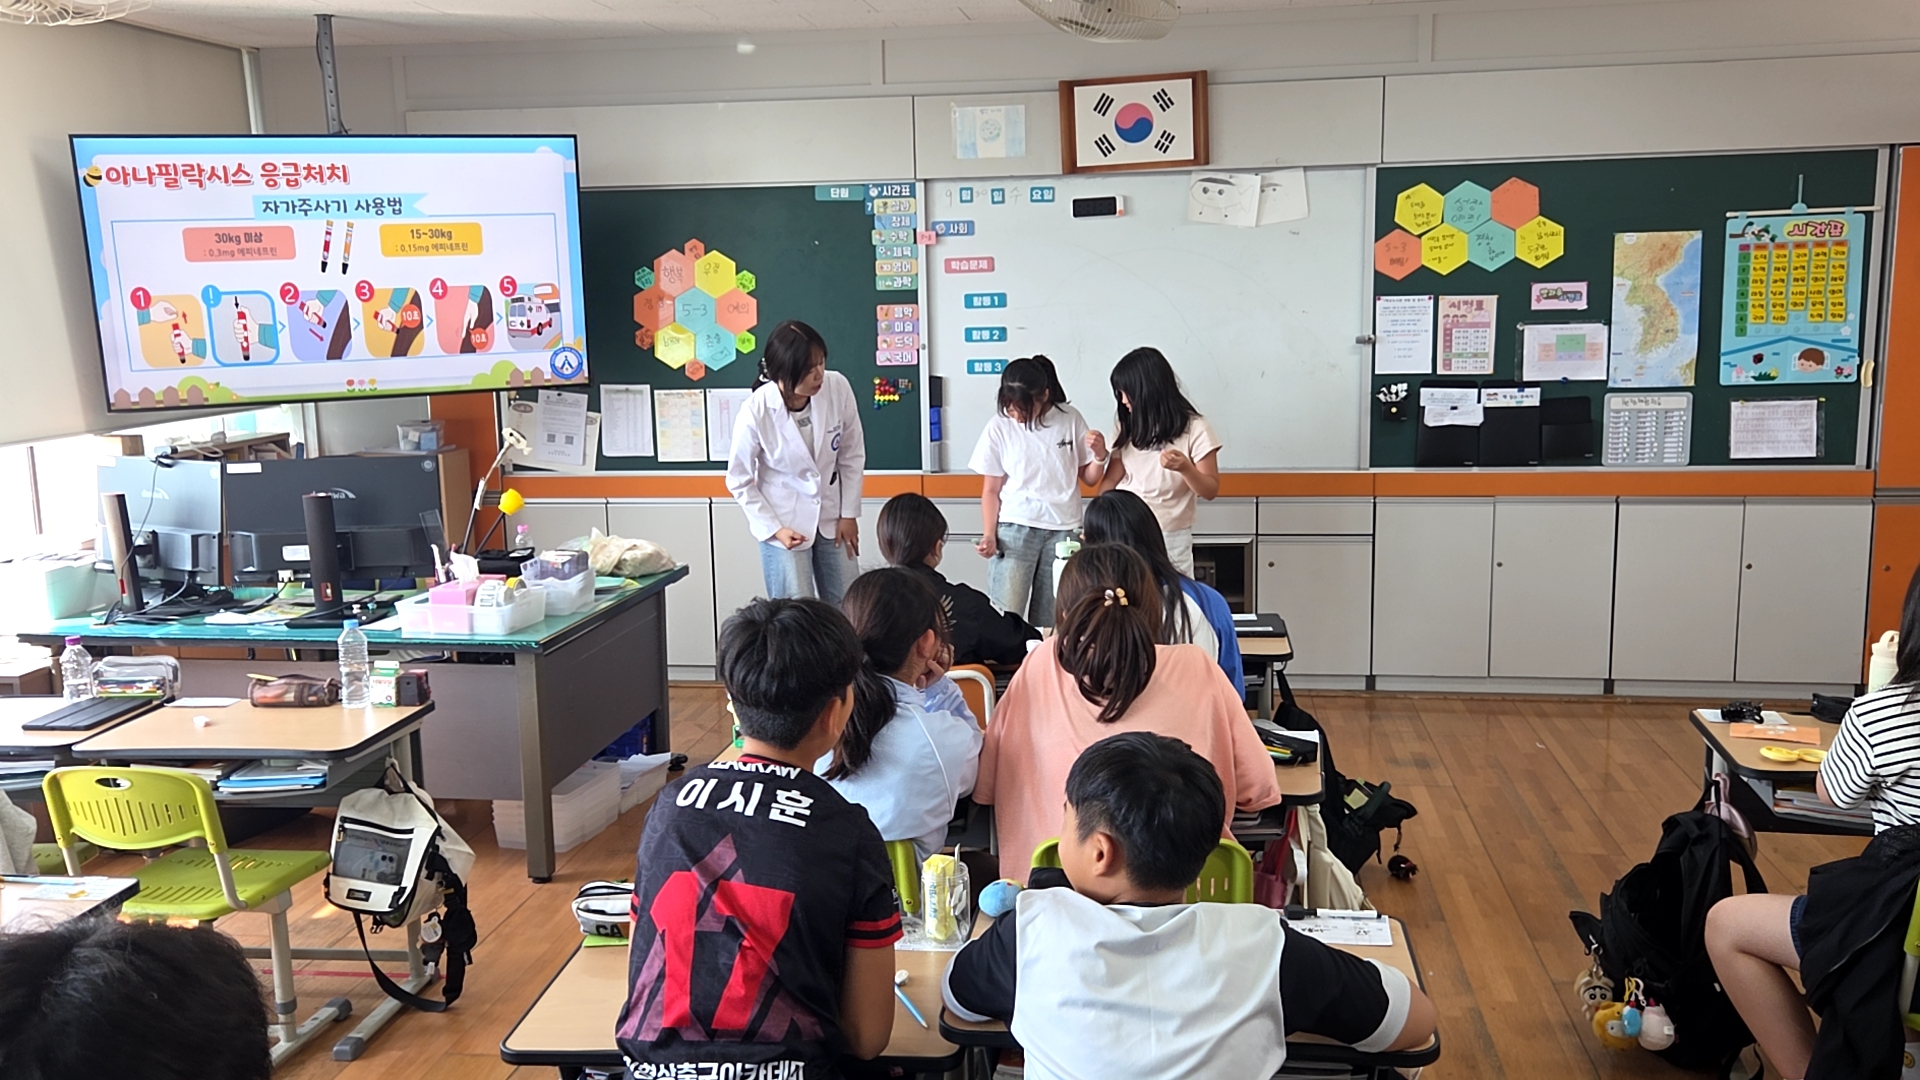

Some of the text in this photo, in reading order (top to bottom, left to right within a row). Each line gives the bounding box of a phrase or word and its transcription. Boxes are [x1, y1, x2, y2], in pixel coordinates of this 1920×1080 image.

[105, 162, 350, 191] 아나필락시스 응급처치
[882, 184, 910, 196] 시간표
[945, 189, 952, 208] 9
[992, 190, 1003, 202] 일
[1010, 186, 1023, 205] 수
[1032, 189, 1054, 200] 요일
[261, 196, 403, 217] 자가주사기 사용법
[409, 228, 453, 241] 15~30kg
[948, 223, 968, 234] 사회
[1788, 220, 1844, 238] 시간표
[214, 232, 241, 245] 30kg
[890, 231, 909, 242] 수학
[236, 246, 278, 258] 에피네프린
[430, 242, 469, 252] 에피네프린
[893, 246, 912, 257] 체육
[1385, 242, 1407, 252] 5-3
[950, 260, 988, 270] 학습문제
[662, 265, 683, 284] 행복
[432, 280, 444, 296] 4
[503, 280, 514, 294] 5
[893, 276, 912, 288] 과학
[137, 290, 145, 307] 1
[284, 285, 295, 303] 2
[360, 285, 370, 300] 3
[972, 296, 998, 306] 활동 1
[682, 303, 708, 317] 5-3
[894, 306, 913, 318] 음악
[894, 322, 913, 332] 미술
[972, 330, 1000, 340] 활동 2
[894, 336, 913, 347] 도덕
[894, 352, 912, 363] 국어
[974, 362, 1002, 372] 활동 3
[650, 871, 795, 1029] 17
